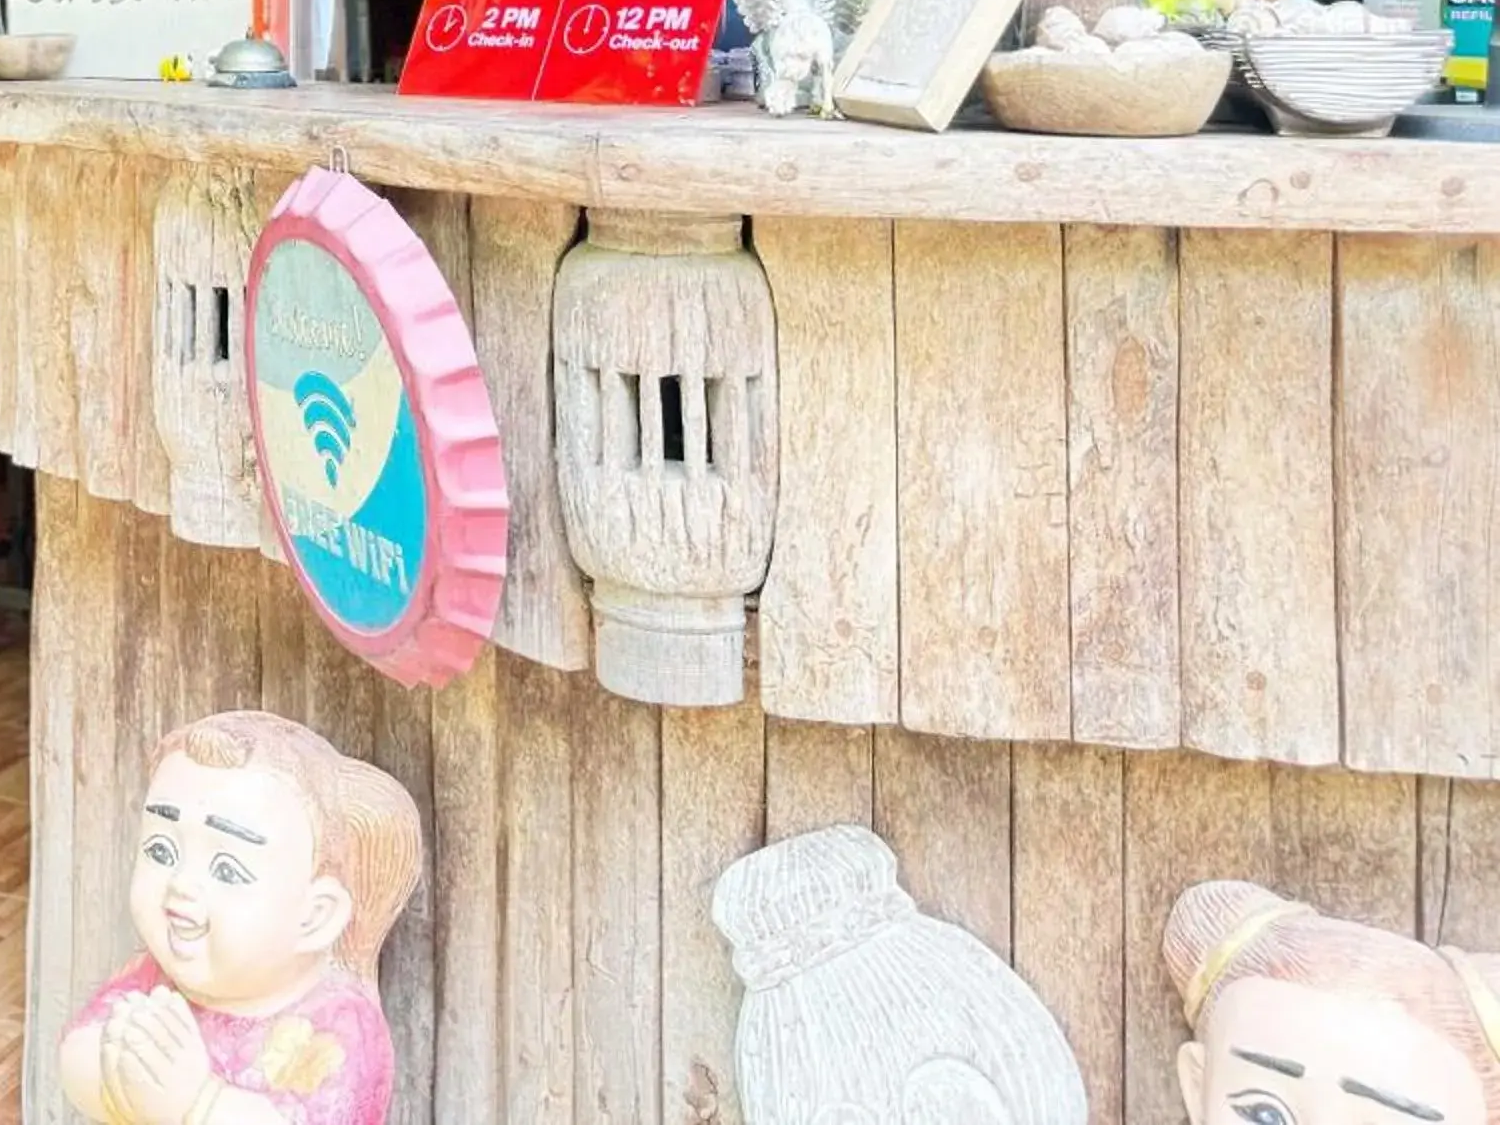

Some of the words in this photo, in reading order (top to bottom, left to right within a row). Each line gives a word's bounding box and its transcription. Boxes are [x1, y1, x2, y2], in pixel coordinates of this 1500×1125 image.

[482, 6, 500, 29] 2
[501, 6, 542, 29] PM
[616, 6, 644, 30] 12
[646, 6, 693, 30] PM
[467, 31, 536, 48] Check-in
[609, 29, 700, 51] Check-out
